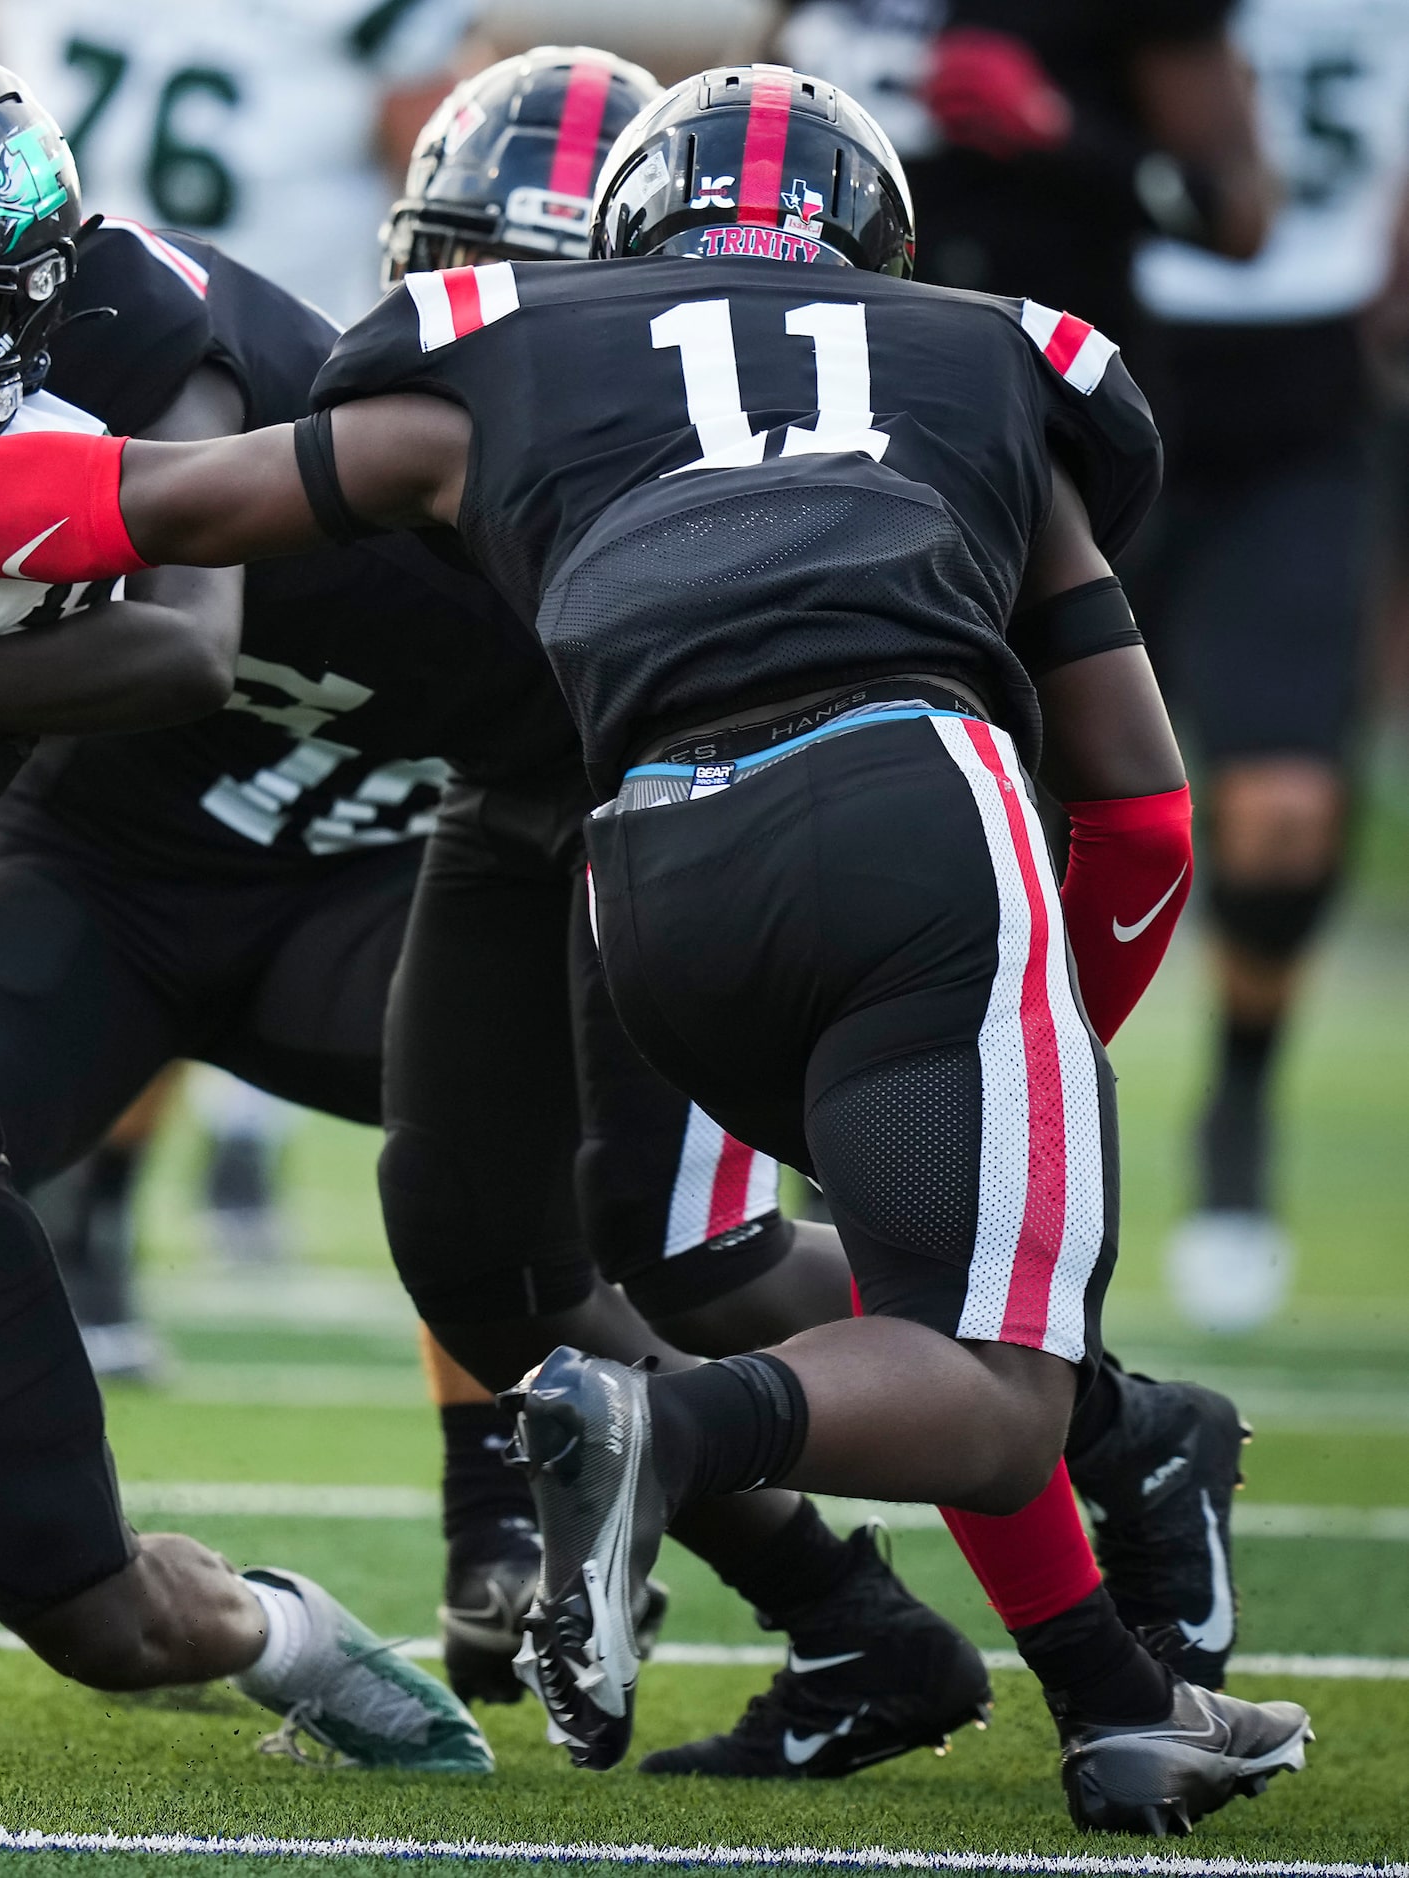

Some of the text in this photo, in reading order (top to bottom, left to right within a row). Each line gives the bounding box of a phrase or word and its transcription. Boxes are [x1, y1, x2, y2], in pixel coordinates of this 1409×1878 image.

[63, 38, 240, 228] 76
[704, 228, 820, 264] TRINITY
[650, 298, 891, 479] 11
[771, 691, 867, 740] HANES
